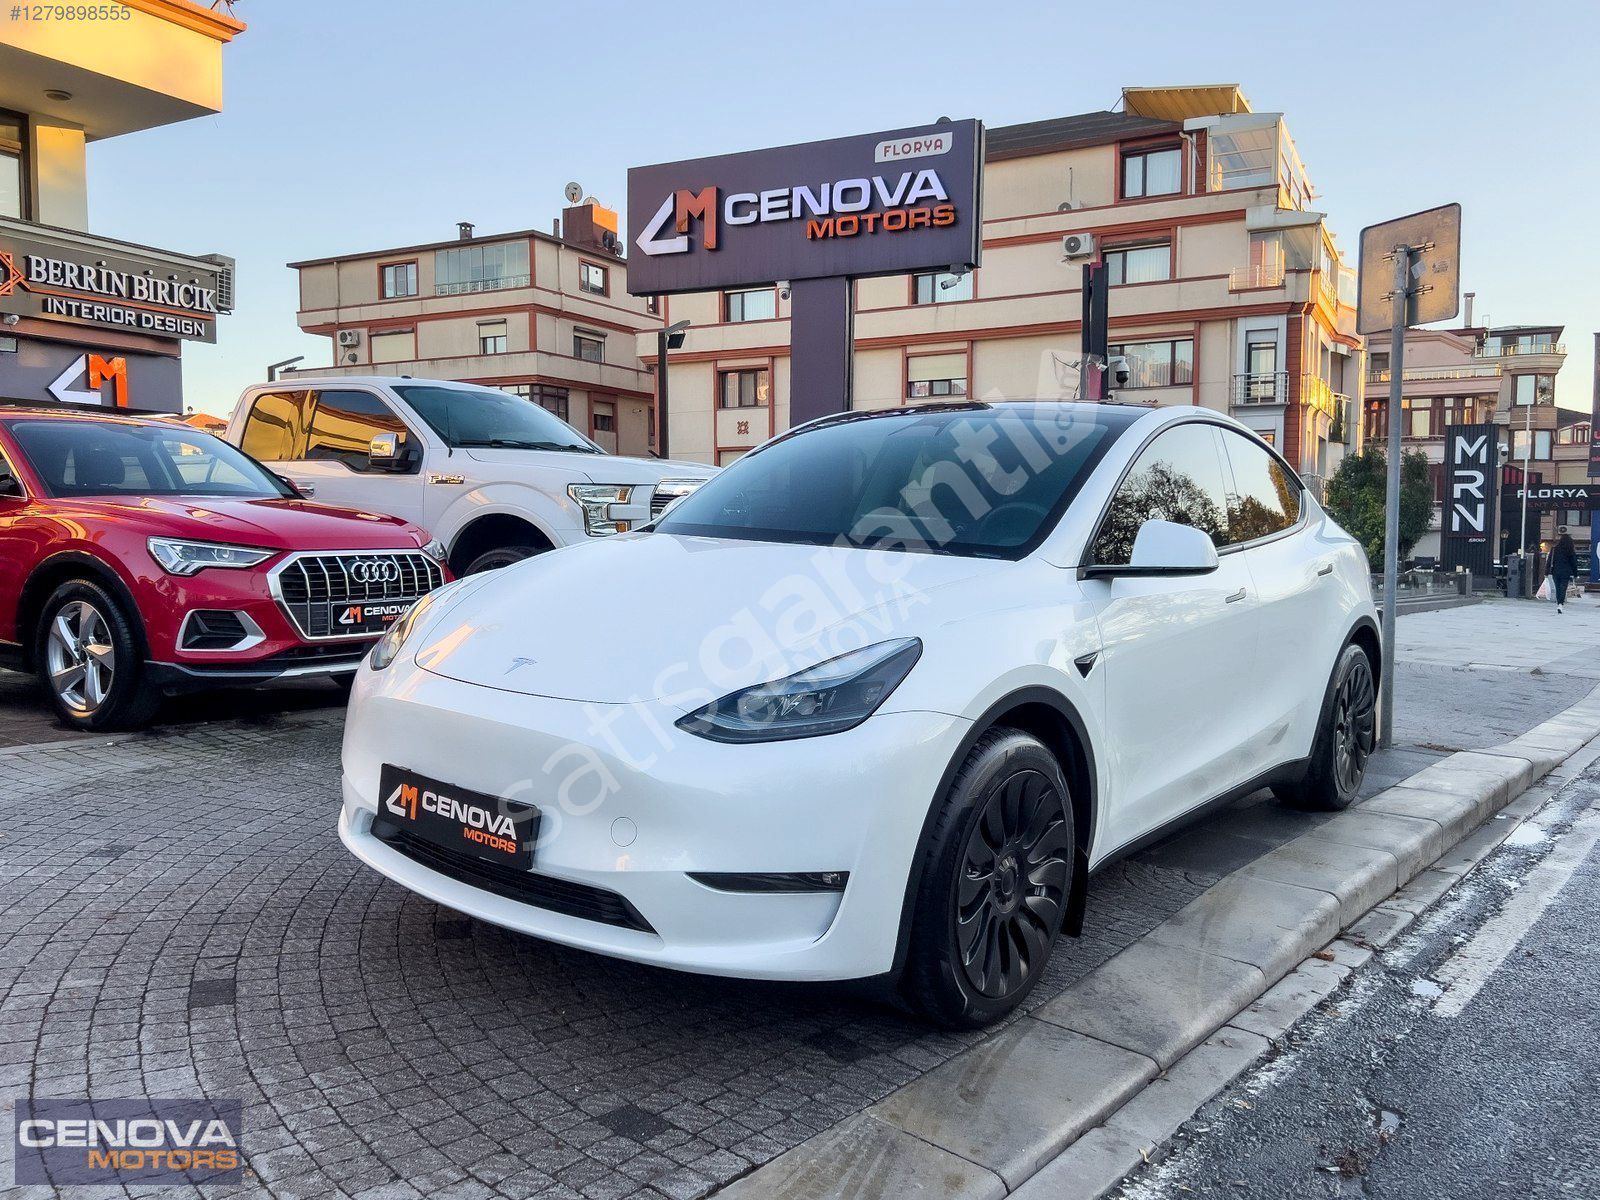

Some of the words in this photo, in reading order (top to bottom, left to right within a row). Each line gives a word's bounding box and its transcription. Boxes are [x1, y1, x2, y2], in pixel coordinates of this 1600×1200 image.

[883, 138, 943, 157] FLORYA
[724, 168, 949, 225] CENOVA
[806, 204, 955, 240] MOTORS
[47, 297, 136, 326] INTERIOR
[141, 312, 205, 337] DESIGN
[1452, 435, 1488, 532] MRN
[421, 790, 517, 841] CENOVA
[463, 827, 517, 854] MOTORS
